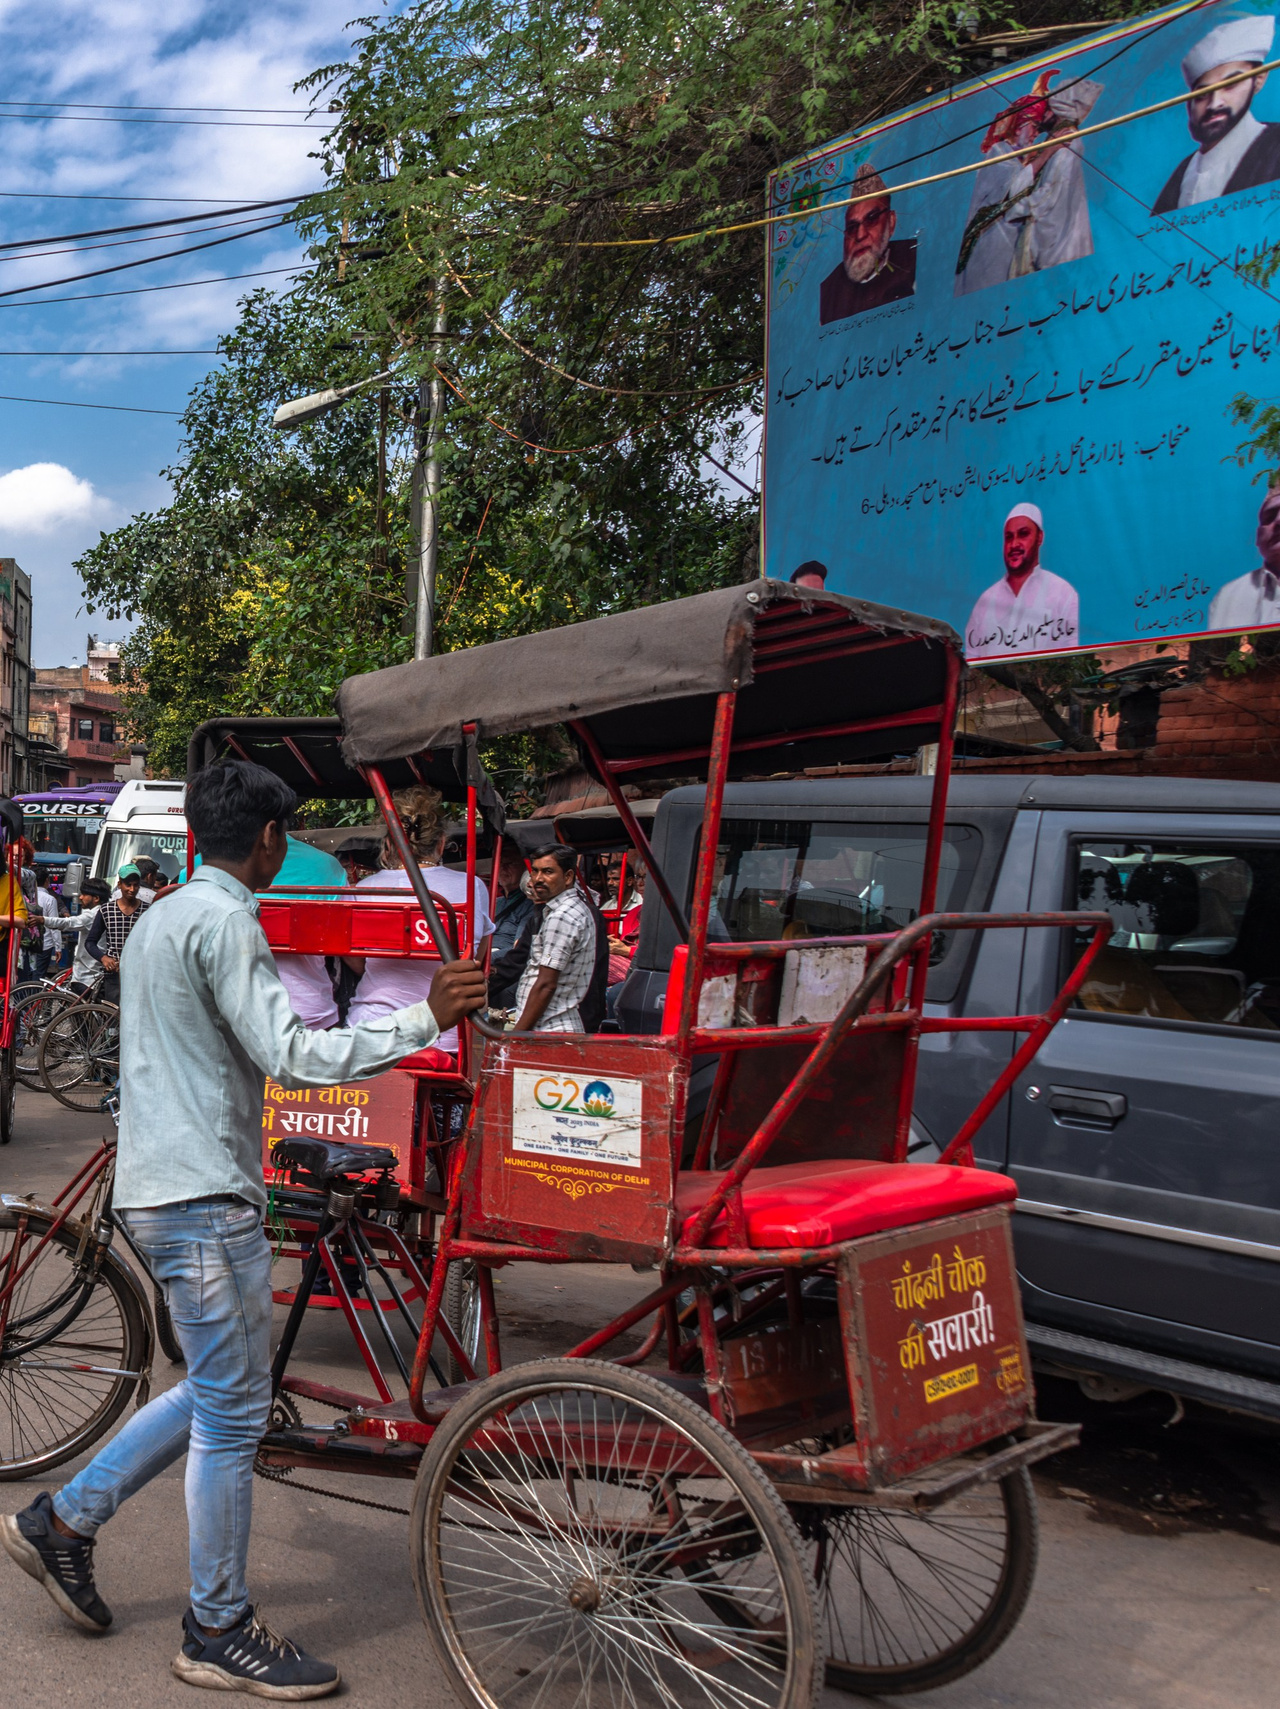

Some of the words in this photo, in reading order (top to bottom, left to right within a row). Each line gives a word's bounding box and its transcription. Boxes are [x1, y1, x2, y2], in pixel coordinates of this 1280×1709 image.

[1028, 288, 1095, 336] صاحب
[1097, 271, 1156, 313] بخاری
[948, 320, 995, 358] جناب
[996, 307, 1026, 338] نے
[877, 332, 924, 377] شعبان
[922, 335, 950, 363] سید
[1131, 340, 1181, 389] مقرر
[775, 366, 792, 404] کو
[784, 368, 834, 408] صاحب
[835, 356, 875, 390] بخاری
[1013, 371, 1041, 411] کے
[922, 395, 947, 440] خیر
[968, 390, 985, 423] کا
[979, 374, 1015, 424] فیصلے
[889, 411, 927, 457] مقدم
[945, 398, 966, 444] ہم
[1051, 618, 1075, 642] حاجی
[280, 1107, 369, 1138] सवारी!
[504, 1156, 550, 1171] MUNICIPAL
[550, 1163, 610, 1180] CORPORATION
[611, 1173, 623, 1182] OF
[624, 1174, 651, 1186] DELHI
[570, 1148, 589, 1156] FAMILY
[607, 1153, 629, 1161] FUTURE
[945, 1245, 988, 1294] चौक
[925, 1291, 996, 1361] सवारी!
